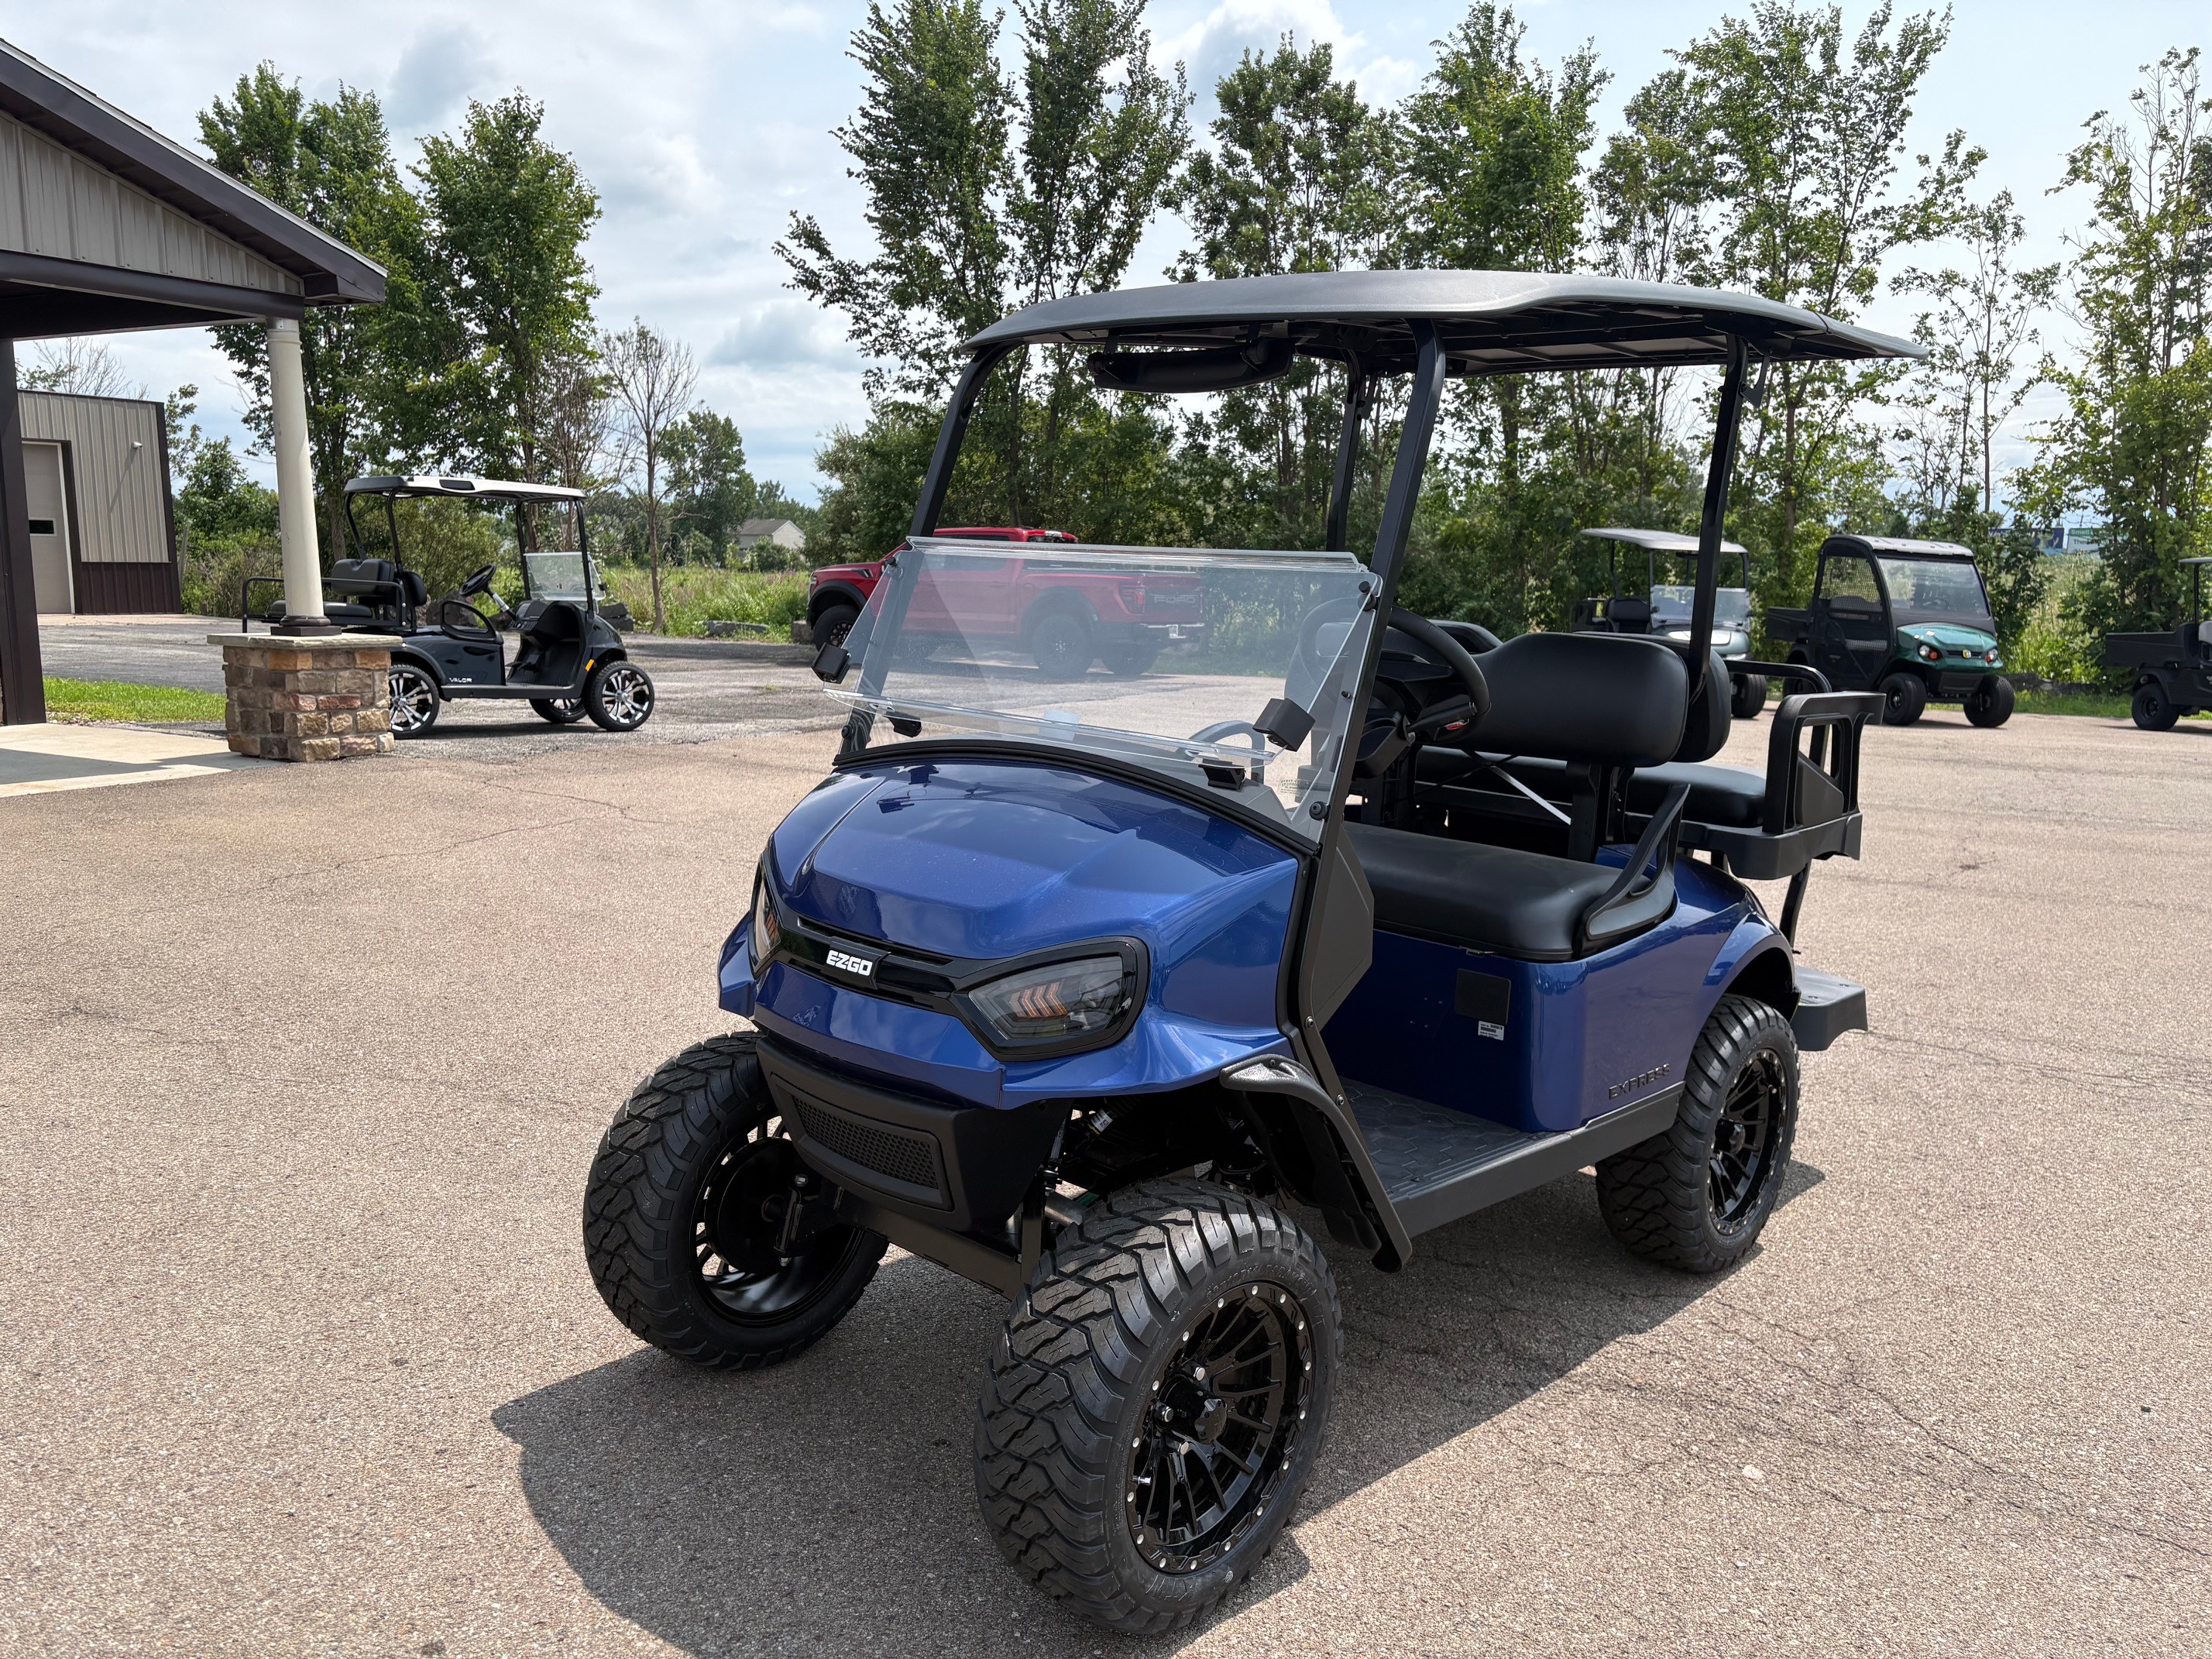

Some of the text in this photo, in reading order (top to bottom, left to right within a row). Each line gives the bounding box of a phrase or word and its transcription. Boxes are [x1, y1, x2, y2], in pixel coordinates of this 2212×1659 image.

[1153, 594, 1196, 603] FORD
[826, 950, 873, 976] EZGO
[1609, 1063, 1670, 1101] EXPRESS
